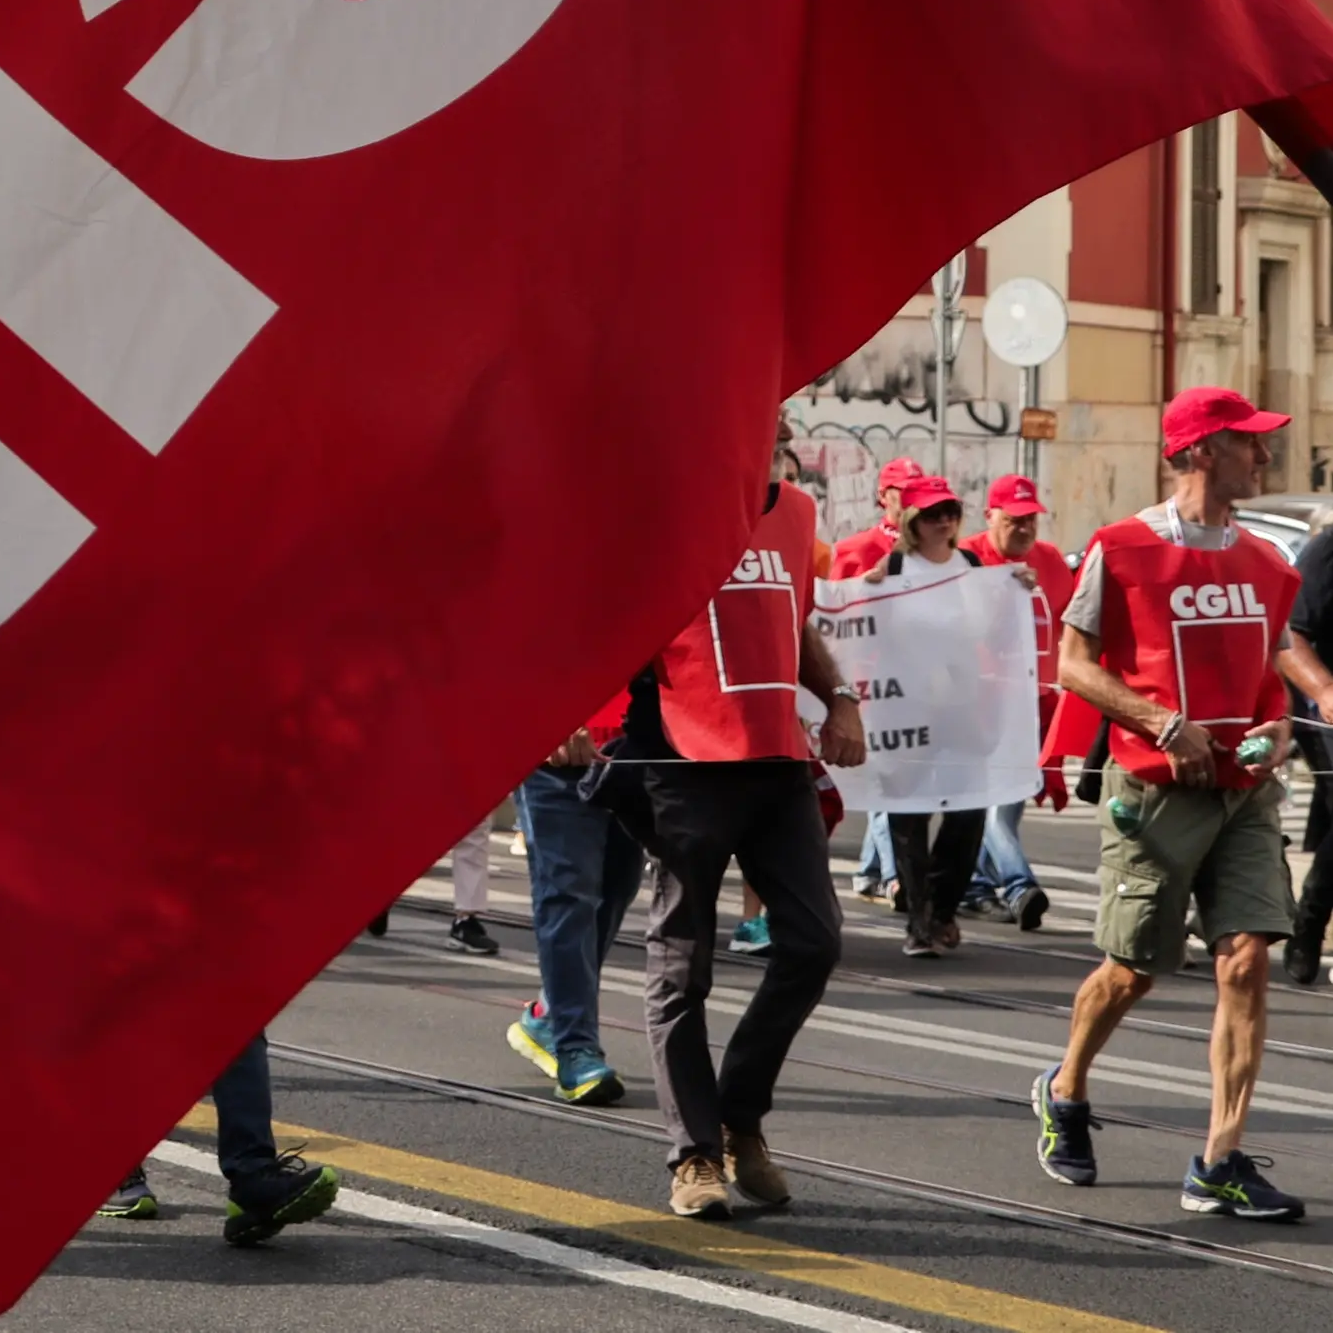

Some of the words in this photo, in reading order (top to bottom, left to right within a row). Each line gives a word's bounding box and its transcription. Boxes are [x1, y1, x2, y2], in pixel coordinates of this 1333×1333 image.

[726, 548, 792, 583] GIL
[1169, 582, 1266, 619] CGIL
[856, 677, 905, 701] ZIA
[868, 725, 930, 752] LUTE
